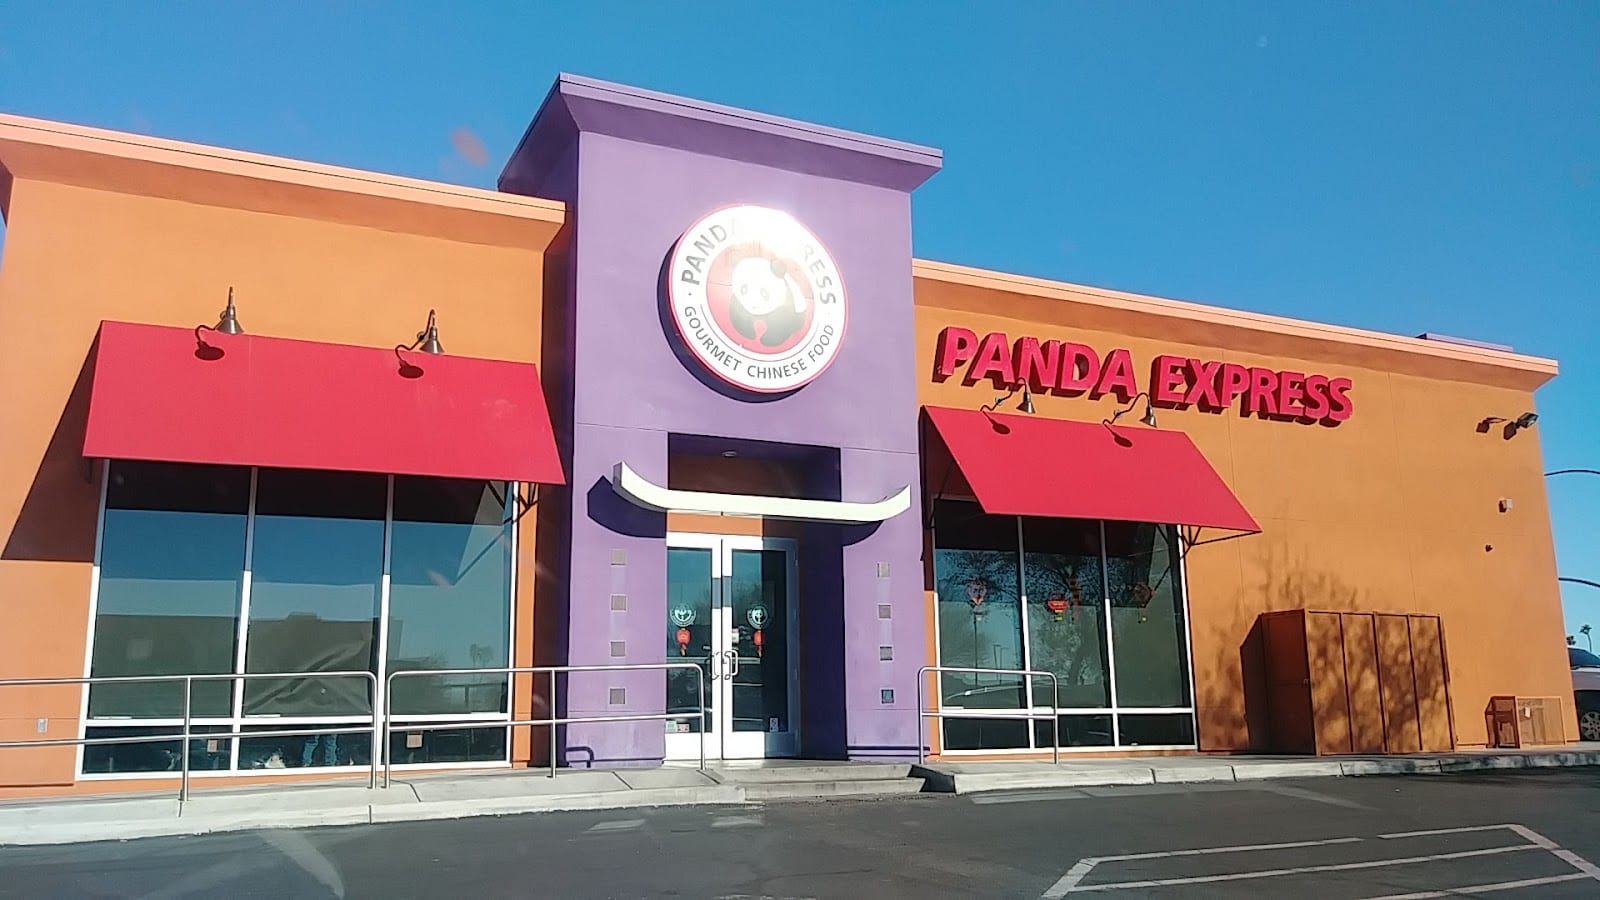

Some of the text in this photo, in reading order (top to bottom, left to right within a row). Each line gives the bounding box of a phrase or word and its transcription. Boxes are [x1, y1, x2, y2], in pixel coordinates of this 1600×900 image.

[684, 306, 835, 380] GOURMET CHINESE FOOD
[934, 326, 1353, 427] PANDA EXPRESS
